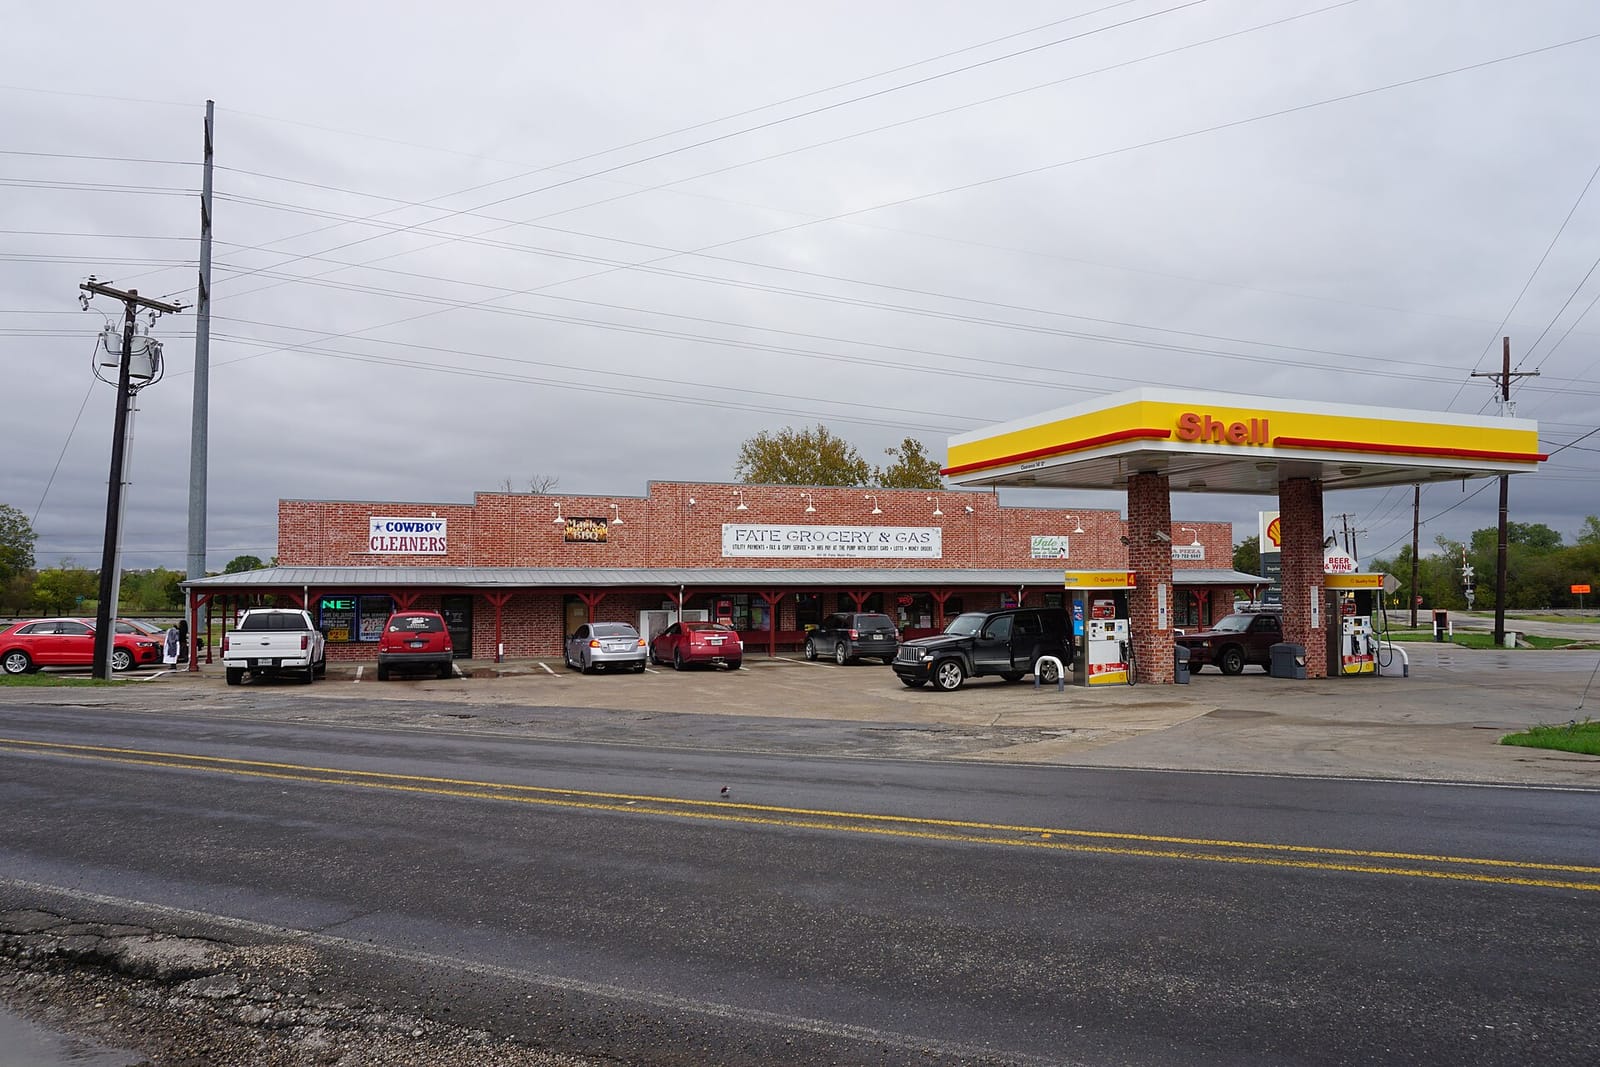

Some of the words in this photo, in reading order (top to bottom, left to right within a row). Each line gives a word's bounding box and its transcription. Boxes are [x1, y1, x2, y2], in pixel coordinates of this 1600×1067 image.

[1177, 412, 1269, 444] Shell
[386, 522, 442, 532] COWBOY
[574, 530, 599, 541] BBQ
[736, 530, 781, 542] FATE
[786, 530, 874, 542] GROCERY
[879, 532, 890, 542] &
[896, 532, 930, 543] GAS
[370, 536, 446, 552] CLEANERS
[1128, 574, 1135, 585] 4
